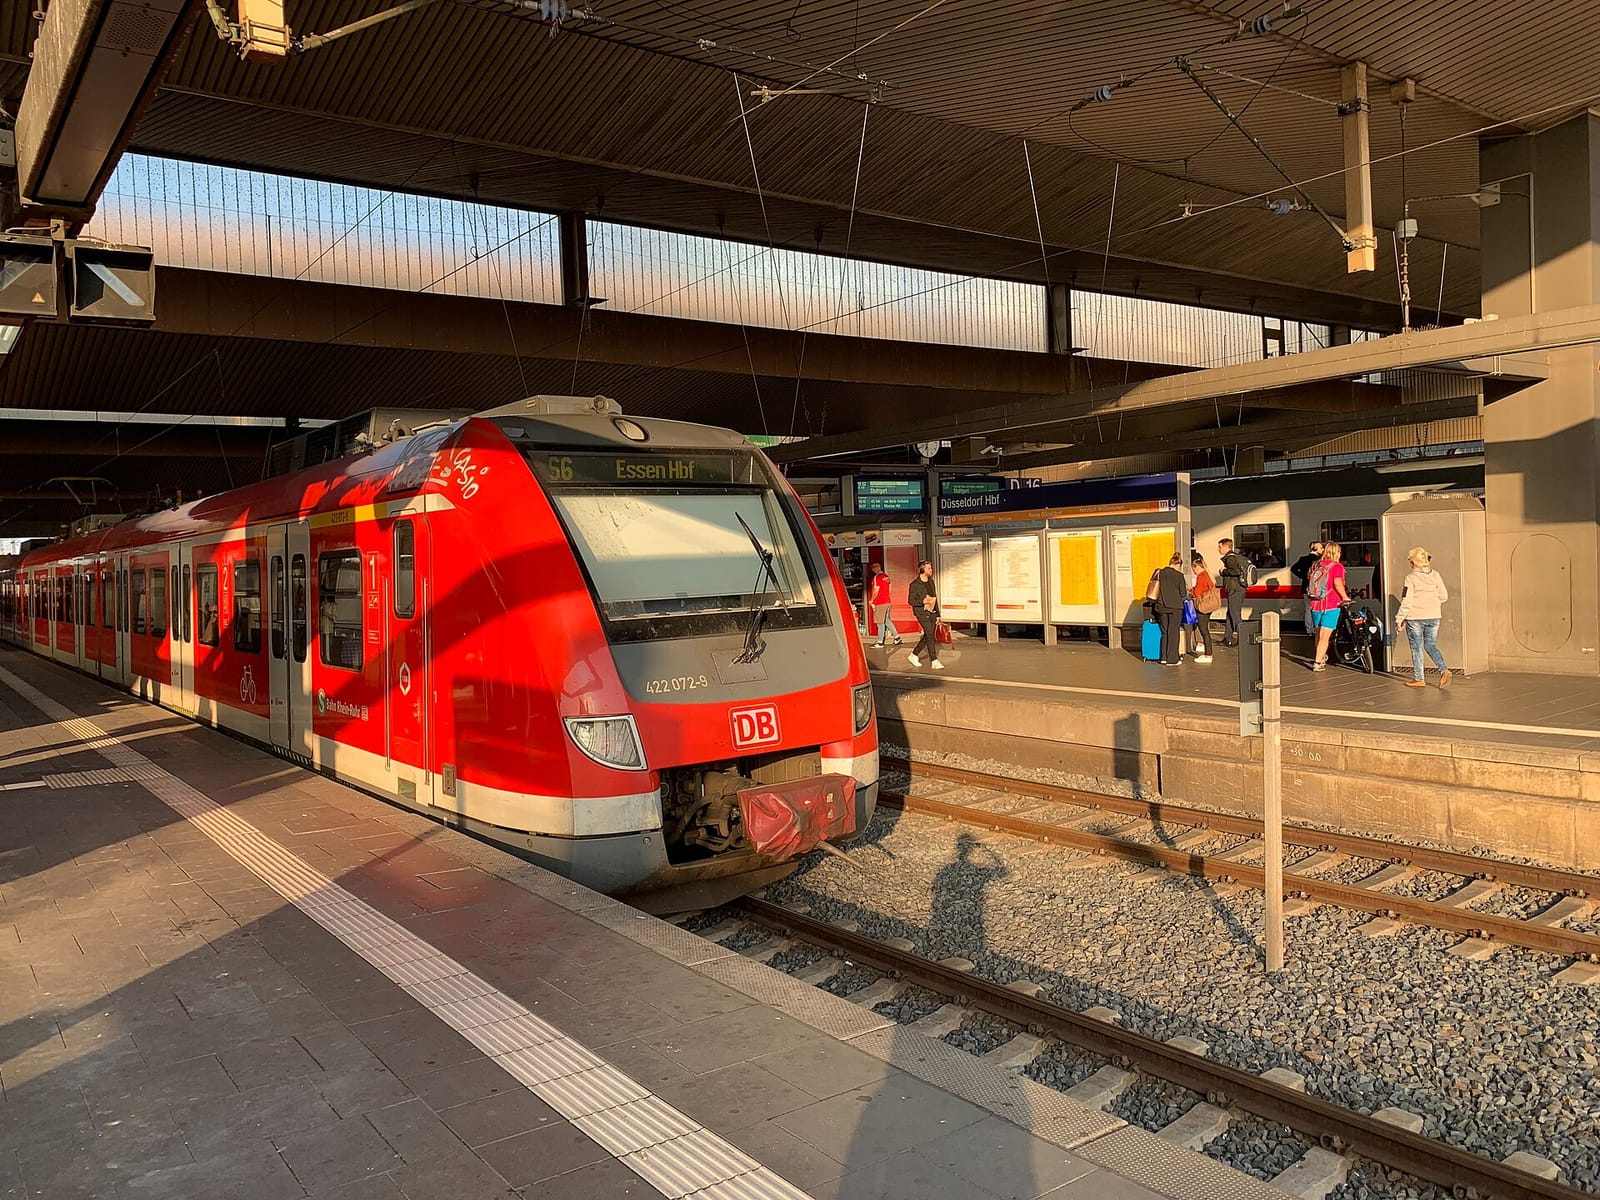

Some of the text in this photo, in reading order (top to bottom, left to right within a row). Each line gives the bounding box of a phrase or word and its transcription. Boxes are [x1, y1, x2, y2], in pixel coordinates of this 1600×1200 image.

[550, 456, 574, 481] S6
[616, 459, 695, 480] Essen Hbf
[941, 494, 999, 509] Düsseldorf Hbf
[223, 566, 228, 591] 2
[369, 555, 375, 590] 1
[646, 675, 708, 694] 422 072-9
[732, 707, 779, 746] DB
